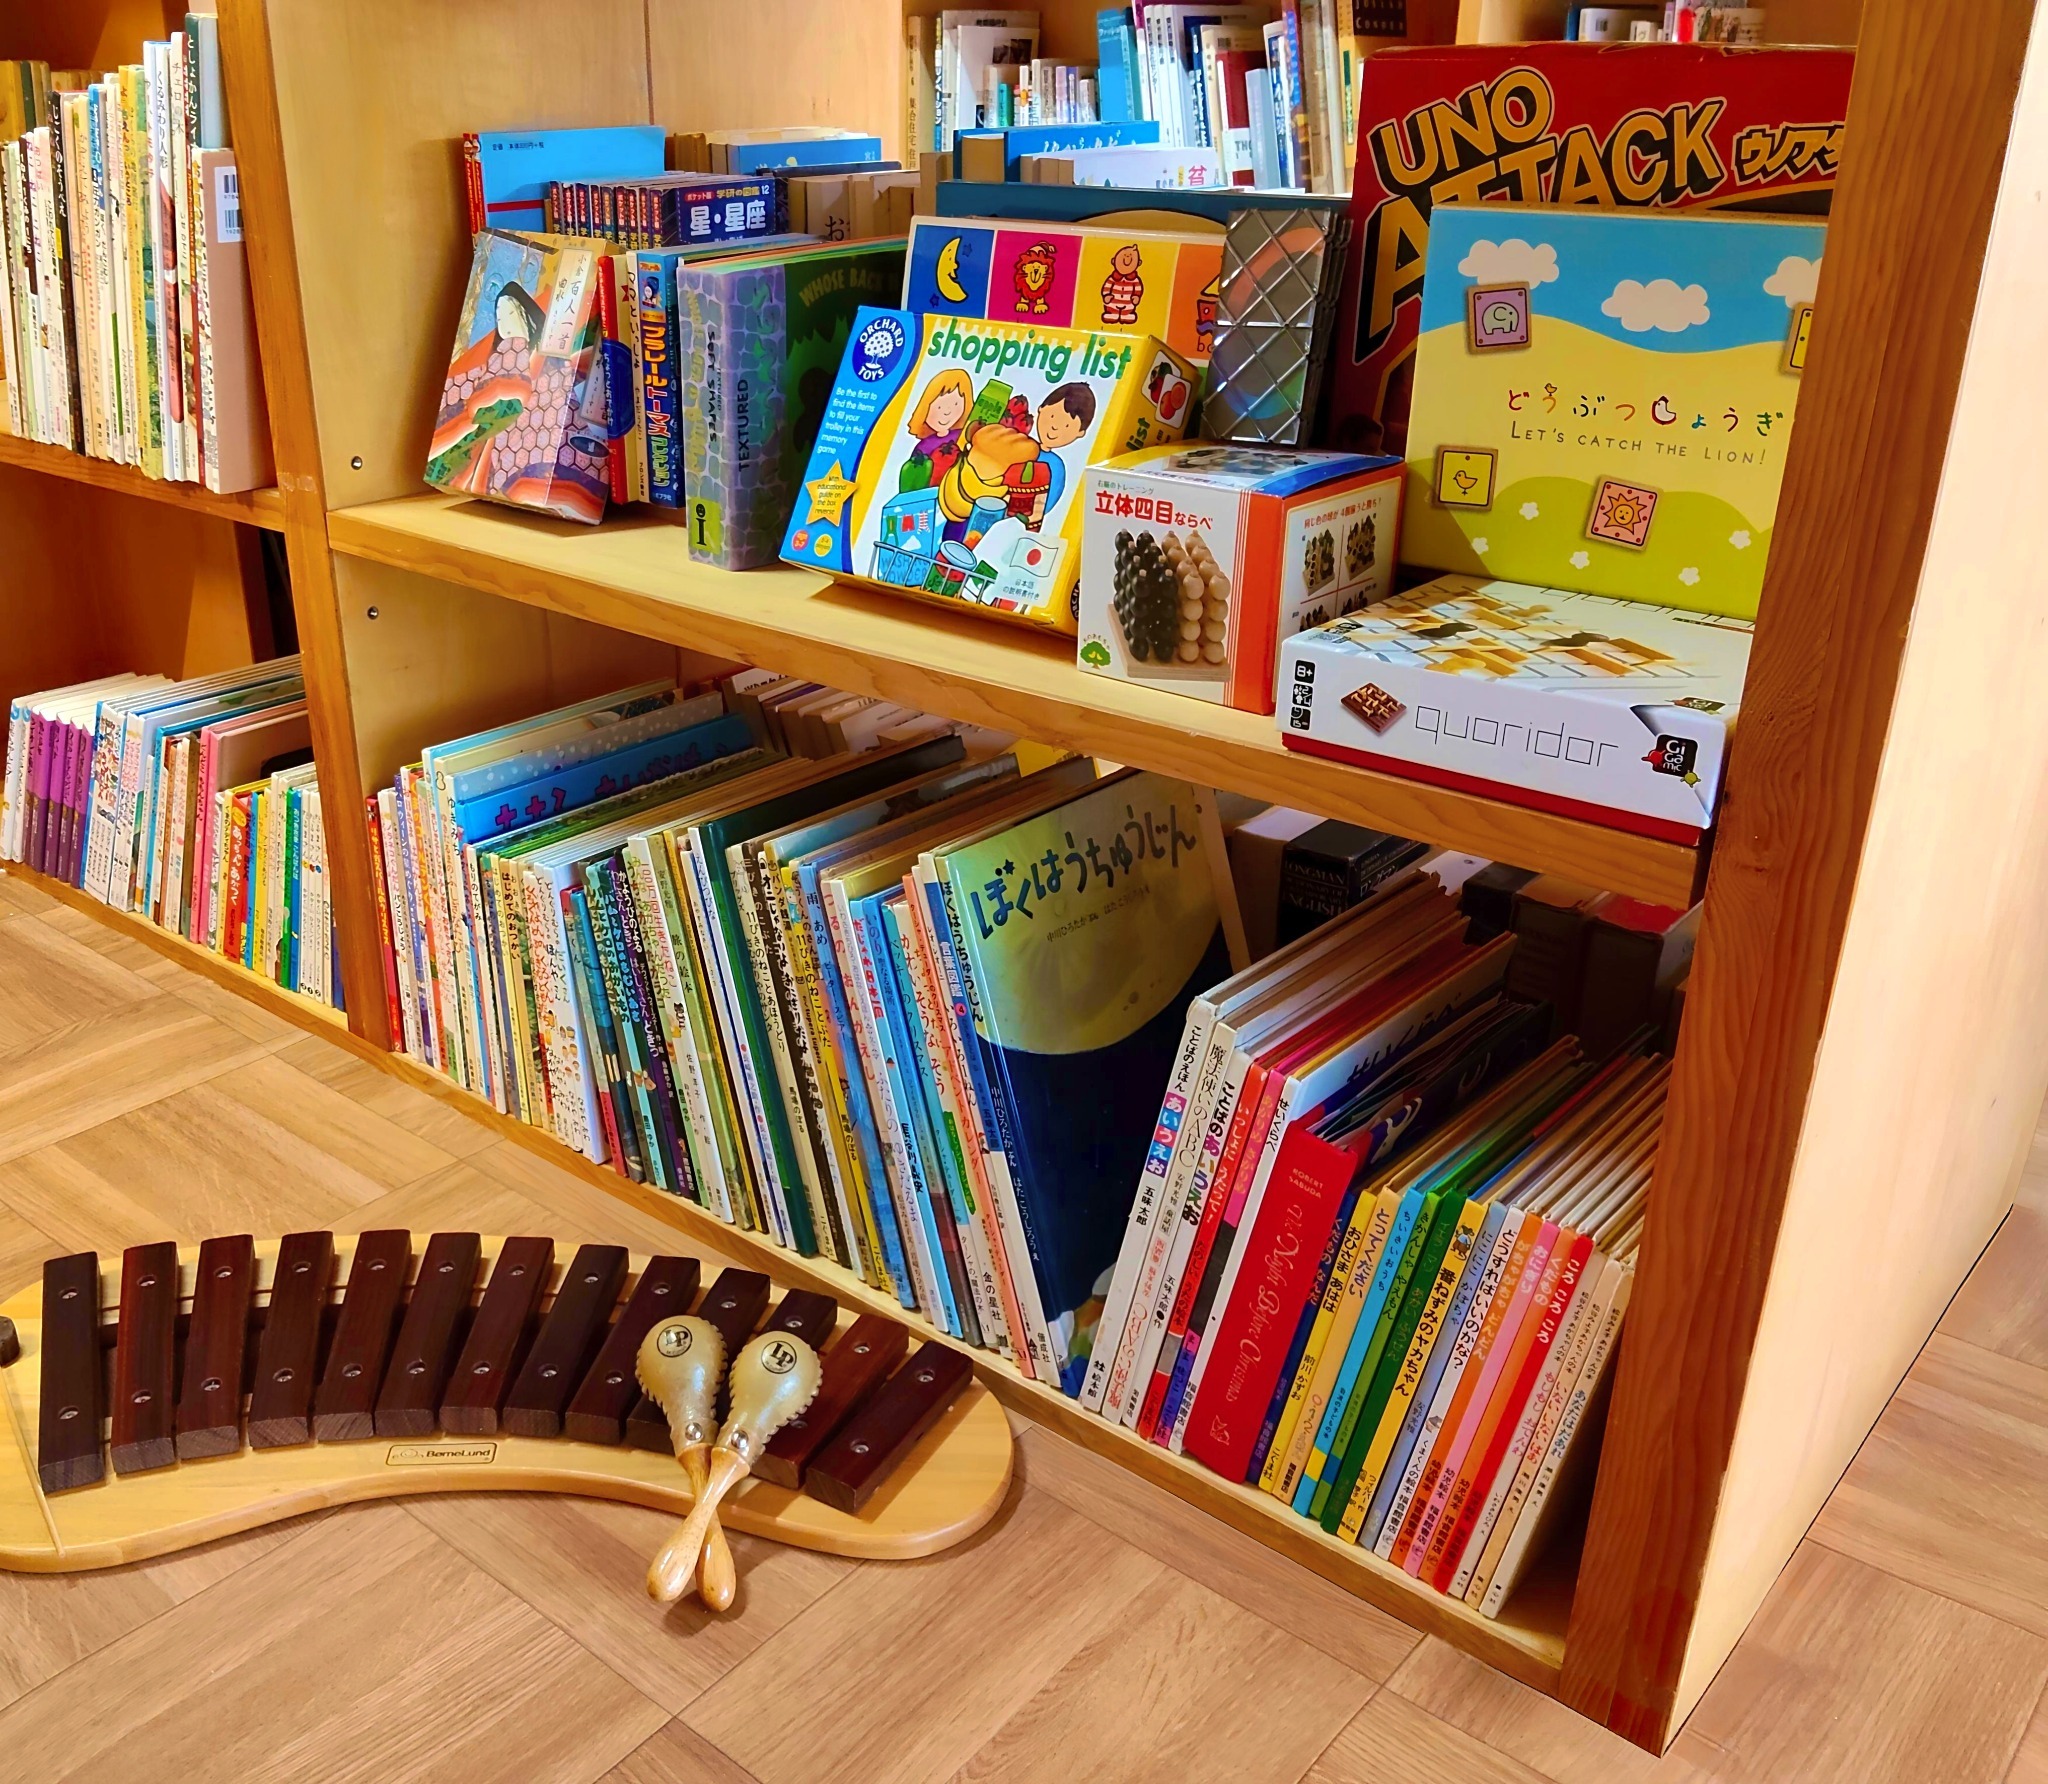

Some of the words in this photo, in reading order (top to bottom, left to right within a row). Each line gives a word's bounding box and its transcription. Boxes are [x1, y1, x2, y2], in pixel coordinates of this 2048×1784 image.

[157, 70, 168, 169] くるみわり人形
[1374, 66, 1554, 194] UNO
[52, 103, 67, 218] じごくのそうべえ
[716, 188, 760, 199] 学研の図鑑
[761, 185, 770, 195] 12
[690, 199, 767, 237] 星・星座
[799, 268, 846, 307] WHOSE
[643, 324, 667, 387] プラレール
[707, 330, 717, 373] SOFT
[859, 318, 904, 349] ORCHARD
[927, 317, 1073, 384] shopping
[1080, 333, 1132, 380] list
[846, 388, 857, 398] the
[857, 389, 870, 399] first
[858, 364, 885, 381] TOYS
[646, 387, 671, 437] トーマス
[707, 376, 718, 443] SHAPES
[737, 378, 750, 472] TEXTURED
[825, 422, 845, 433] trolley
[852, 425, 864, 435] this
[833, 398, 846, 408] find
[846, 400, 857, 409] the
[857, 401, 875, 412] items
[837, 410, 845, 420] fill
[844, 414, 860, 423] your
[816, 445, 837, 454] game
[821, 434, 848, 446] memory
[1126, 416, 1151, 450] list
[1511, 420, 1565, 444] LET'S
[1577, 433, 1643, 452] CATCH
[1656, 441, 1687, 457] THE
[1704, 446, 1767, 465] LION!
[819, 491, 834, 499] guide
[1094, 490, 1214, 531] 立体四目ならべ
[1003, 586, 1040, 600] の説明書付き
[1014, 579, 1035, 589] 日本語
[1296, 664, 1313, 678] 8+
[1415, 705, 1619, 767] quoridor
[447, 797, 461, 857] ゆきみち
[229, 825, 243, 906] あっちゃんあがつく
[970, 804, 1197, 940] ぼくはうちゅうじん
[469, 863, 482, 921] もりのてがみ
[618, 870, 643, 954] かようびのよる
[743, 857, 775, 955] 三びきのこぶた
[772, 874, 793, 932] パンダ銭湯
[502, 872, 521, 961] はじめてのおつかい
[563, 907, 582, 964] かばくん
[806, 892, 828, 945] 雨、あめ
[864, 913, 882, 956] いのり
[1046, 915, 1088, 943] 中川ひろたか
[671, 934, 694, 994] 旅の絵本
[746, 910, 786, 1053] 11ぴきのねことあほうとり
[823, 892, 877, 1082] つるのおんがえし
[852, 917, 885, 1020] だじゃれ日本一周
[939, 940, 964, 999] 言葉図鑑
[795, 934, 833, 1049] 11ぴきのねことぶた
[889, 938, 929, 1078] ベッキーのクリスマス
[1174, 1024, 1202, 1093] ことばのえほん
[789, 1086, 805, 1134] 馬場のぼる
[941, 1045, 981, 1186] アドベントカレンダー
[990, 1085, 1014, 1151] 中川ひろたか
[1178, 1042, 1228, 1169] 魔法使いのABC
[1220, 1098, 1252, 1161] いっしょに
[1265, 1096, 1291, 1153] せいくらべ
[840, 1113, 857, 1161] 馬場のぼる
[900, 1122, 924, 1194] 長谷川義史
[1146, 1095, 1187, 1176] あいうえお
[1181, 1080, 1235, 1227] ことばのあいうえお
[1168, 1171, 1185, 1207] 安野光雅
[1288, 1175, 1322, 1199] SABUDA
[1292, 1167, 1324, 1189] ROBERT
[1135, 1186, 1156, 1226] 五味太郎
[1283, 1203, 1304, 1229] The
[819, 1215, 836, 1263] こぐま社
[1264, 1233, 1302, 1287] Night
[1321, 1217, 1342, 1265] くだもの
[1336, 1225, 1362, 1274] おひさま
[1348, 1207, 1391, 1300] とってください
[1378, 1210, 1411, 1292] ちいさいおうち
[1405, 1211, 1429, 1269] きかんしゃ
[1468, 1230, 1494, 1277] にこにこ
[873, 1245, 888, 1288] こぐま社
[1498, 1239, 1532, 1308] がちゃがちゃ
[1519, 1244, 1549, 1295] おにぎり
[1534, 1256, 1562, 1307] くだもの
[1561, 1258, 1580, 1285] ころ
[982, 1271, 1003, 1321] 金の星社
[1158, 1274, 1176, 1314] 五味太郎
[1248, 1284, 1281, 1338] Before
[1322, 1276, 1344, 1314] あはは
[1382, 1273, 1408, 1321] やえもん
[1451, 1282, 1473, 1326] かぼちゃ
[1453, 1228, 1519, 1371] どうすればいいのかな?
[1548, 1289, 1568, 1315] ころ
[663, 1329, 689, 1348] LP
[770, 1342, 794, 1368] LP
[1036, 1331, 1051, 1364] 偕成社
[1394, 1266, 1457, 1398] 番ねずみのヤカちゃん
[1472, 1311, 1503, 1362] どんどん
[1536, 1319, 1556, 1345] ころ
[1087, 1372, 1102, 1399] 絵本館
[1225, 1338, 1262, 1403] Christmas
[1290, 1375, 1308, 1401] かずお
[1300, 1353, 1317, 1375] 前川
[1175, 1381, 1197, 1427] 福音館書店
[1532, 1371, 1555, 1414] もしもし
[1511, 1417, 1538, 1458] おでんわ
[1550, 1388, 1588, 1459] あなたはだあれ
[1262, 1447, 1281, 1482] こぐま社
[1402, 1439, 1430, 1495] くまくんの絵本
[1421, 1458, 1442, 1493] 幼児絵本
[1435, 1467, 1456, 1500] 幼児絵本
[1387, 1495, 1410, 1536] 福音館書店
[1450, 1477, 1471, 1512] 幼児絵本
[1416, 1504, 1440, 1546] 福音館書店
[1431, 1514, 1456, 1556] 福音館書店
